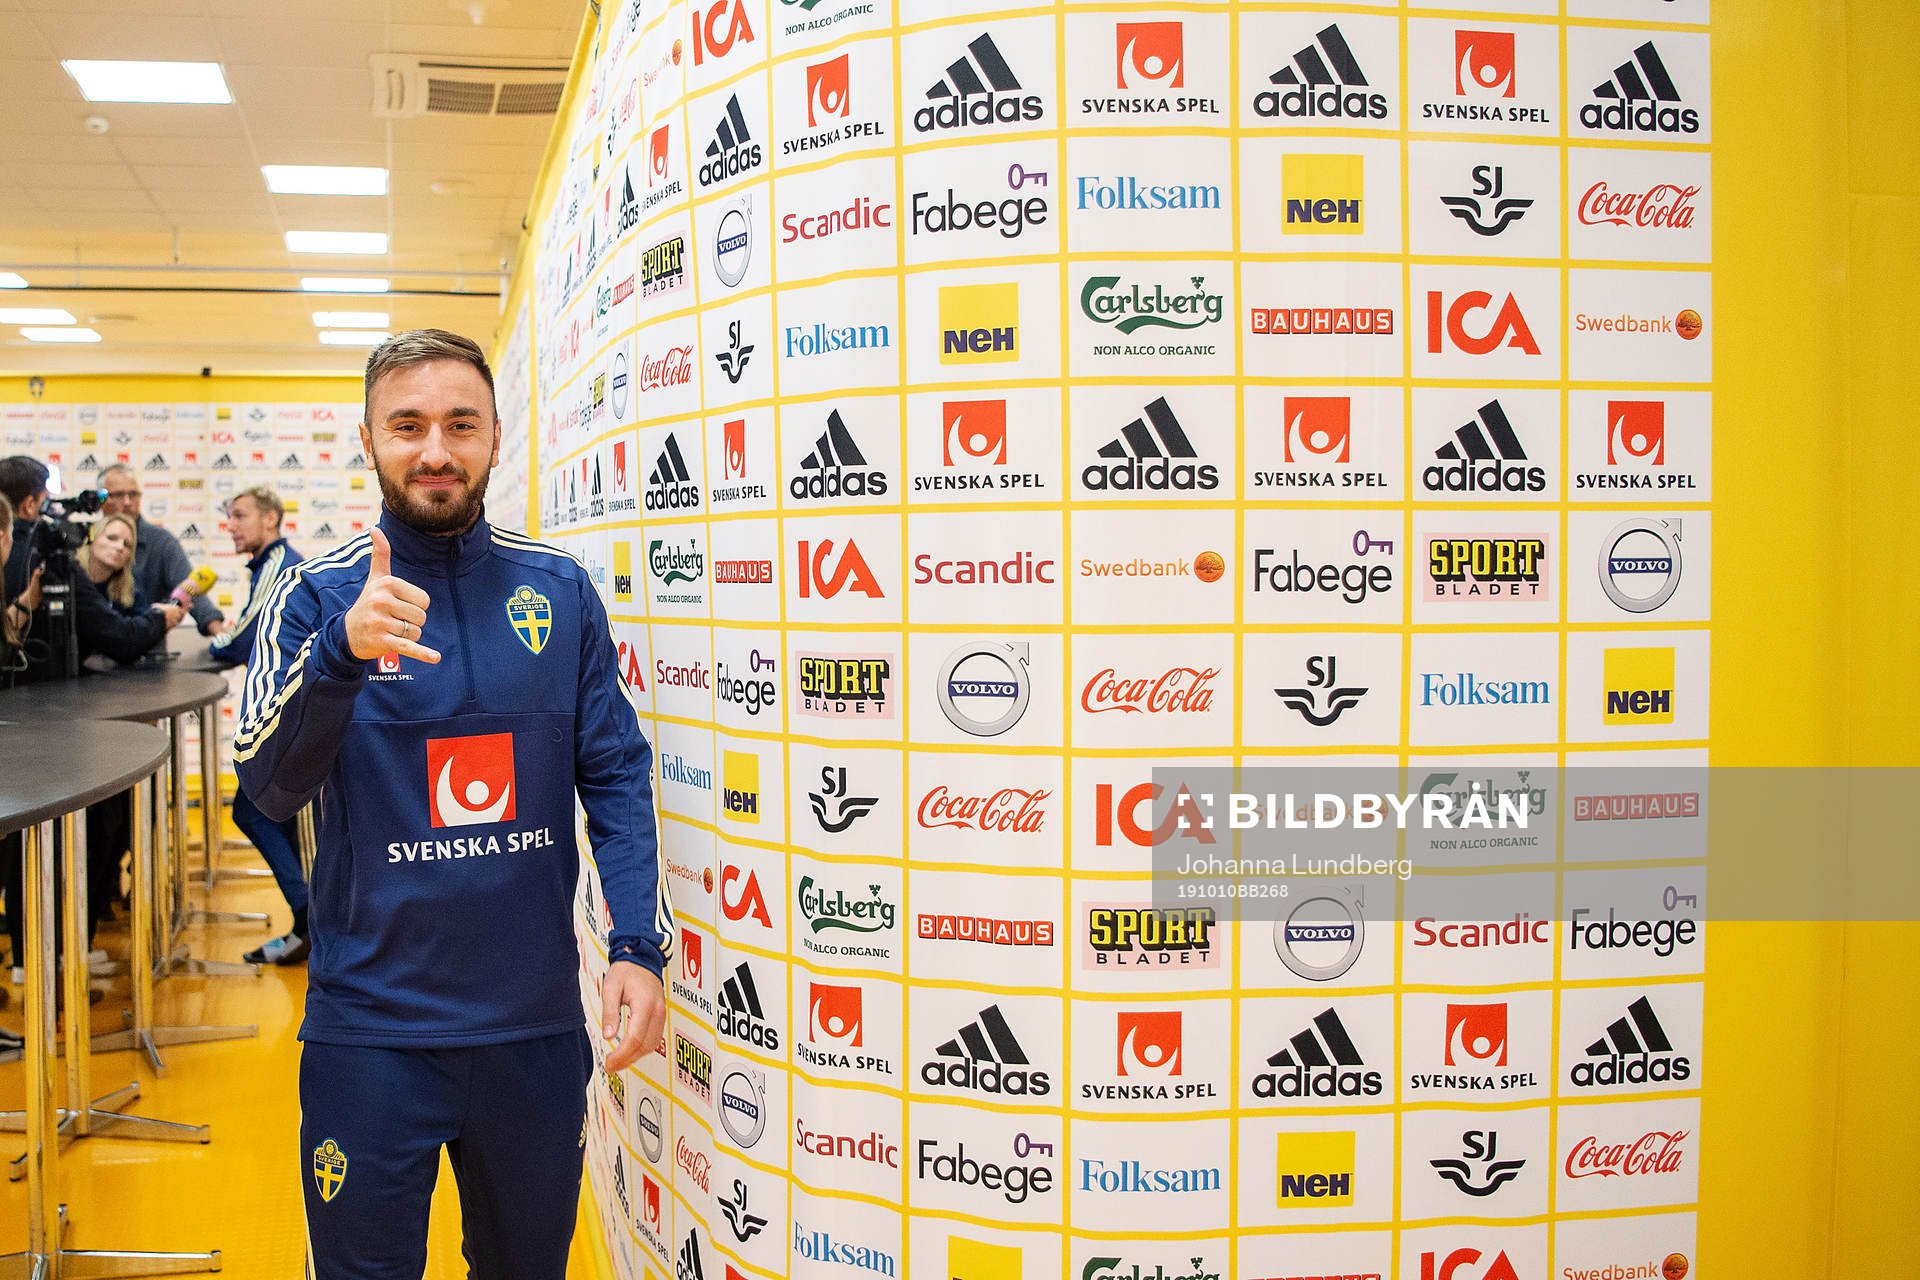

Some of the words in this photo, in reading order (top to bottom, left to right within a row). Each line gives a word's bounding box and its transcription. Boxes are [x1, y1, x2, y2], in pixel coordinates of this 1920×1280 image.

[692, 0, 755, 66] ICA
[785, 24, 805, 36] NON
[807, 18, 832, 31] ALCO
[833, 4, 874, 24] ORGANIC
[914, 93, 1044, 132] adidas
[1082, 97, 1170, 114] SVENSKA
[1176, 98, 1219, 114] SPEL
[1253, 84, 1389, 120] adidas
[1422, 103, 1504, 122] SVENSKA
[1508, 106, 1550, 124] SPEL
[1580, 99, 1700, 134] adidas
[783, 130, 840, 154] SVENSKA
[844, 122, 884, 139] SPEL
[700, 143, 761, 187] adidas
[664, 181, 682, 198] SPEL
[1076, 176, 1221, 211] Folksam
[1471, 165, 1503, 200] SJ
[782, 197, 891, 243] Scandic
[912, 189, 1048, 239] Fabege
[1577, 181, 1703, 230] Coca-Cola
[719, 235, 747, 252] VOLVO
[642, 237, 684, 286] SPORT
[643, 275, 683, 297] BLADET
[1080, 276, 1223, 324] Carlsberg
[729, 320, 741, 350] SJ
[1252, 309, 1393, 334] BAUHAUS
[1427, 290, 1542, 356] ICA
[1575, 313, 1672, 334] Swedbank
[786, 322, 891, 358] Folksam
[1093, 345, 1120, 356] NON
[1122, 345, 1156, 356] ALCO
[1158, 345, 1216, 356] ORGANIC
[641, 345, 694, 392] Coca-Cola
[790, 466, 888, 499] adidas
[914, 475, 994, 491] SVENSKA
[1000, 473, 1045, 489] SPEL
[1081, 457, 1219, 491] adidas
[1254, 471, 1335, 487] SVENSKA
[1342, 471, 1388, 487] SPEL
[1423, 458, 1546, 492] adidas
[1575, 473, 1653, 489] SVENSKA
[1657, 474, 1697, 490] SPEL
[646, 482, 699, 511] adidas
[712, 488, 740, 502] SVENSKA
[742, 486, 766, 500] SPEL
[649, 539, 704, 578] Carlsberg
[715, 561, 772, 583] BAUHAUS
[798, 538, 885, 599] ICA
[914, 551, 1054, 585] Scandic
[1080, 558, 1190, 577] Swedbank
[1429, 539, 1544, 582] SPORT
[1611, 559, 1669, 572] VOLVO
[1254, 549, 1393, 604] Fabege
[1435, 584, 1540, 596] BLADET
[657, 659, 709, 690] Scandic
[800, 658, 890, 700] SPORT
[1306, 655, 1336, 688] SJ
[717, 663, 776, 715] Fabege
[805, 699, 885, 713] BLADET
[951, 683, 1016, 696] VOLVO
[1081, 667, 1223, 714] Coca-Cola
[1419, 672, 1551, 707] Folksam
[661, 753, 712, 790] Folksam
[822, 766, 847, 798] SJ
[917, 785, 1054, 833] Coca-Cola
[1096, 781, 1217, 847] ICA
[1574, 793, 1699, 820] BAUHAUS
[387, 835, 501, 863] SVENSKA
[507, 827, 554, 854] SPEL
[1430, 840, 1457, 849] NON
[1460, 838, 1487, 849] ALCO
[1490, 837, 1538, 847] ORGANIC
[666, 858, 702, 885] Swedbank
[798, 875, 895, 929] Carlsberg
[918, 914, 1053, 946] BAUHAUS
[1089, 907, 1216, 952] SPORT
[1288, 926, 1352, 940] VOLVO
[1413, 912, 1549, 948] Scandic
[1570, 908, 1697, 957] Fabege
[813, 942, 838, 955] ALCO
[841, 946, 890, 959] ORGANIC
[1096, 951, 1209, 965] BLADET
[672, 981, 698, 1006] SVENSKA
[699, 997, 713, 1016] SPEL
[717, 1010, 779, 1050] didas
[676, 1033, 712, 1087] SPORT
[798, 1043, 850, 1068] SVENSKA
[856, 1055, 892, 1074] SPEL
[1570, 1053, 1691, 1088] adidas
[678, 1070, 712, 1102] BLADET
[921, 1059, 1051, 1096] adidas
[1082, 1084, 1168, 1099] SVENSKA
[1174, 1083, 1217, 1098] SPEL
[1252, 1065, 1383, 1098] adidas
[1411, 1074, 1495, 1090] SVENSKA
[1500, 1072, 1537, 1088] SPEL
[724, 1095, 757, 1116] VOLVO
[796, 1118, 898, 1168] Scandic
[1462, 1130, 1496, 1162] SJ
[1565, 1130, 1691, 1179] Coca-Cola
[676, 1135, 712, 1194] Coca-Cola
[918, 1139, 1053, 1204] Fabege
[1079, 1158, 1221, 1193] Folksam
[734, 1179, 747, 1210] SJ
[794, 1221, 895, 1278] Folksam
